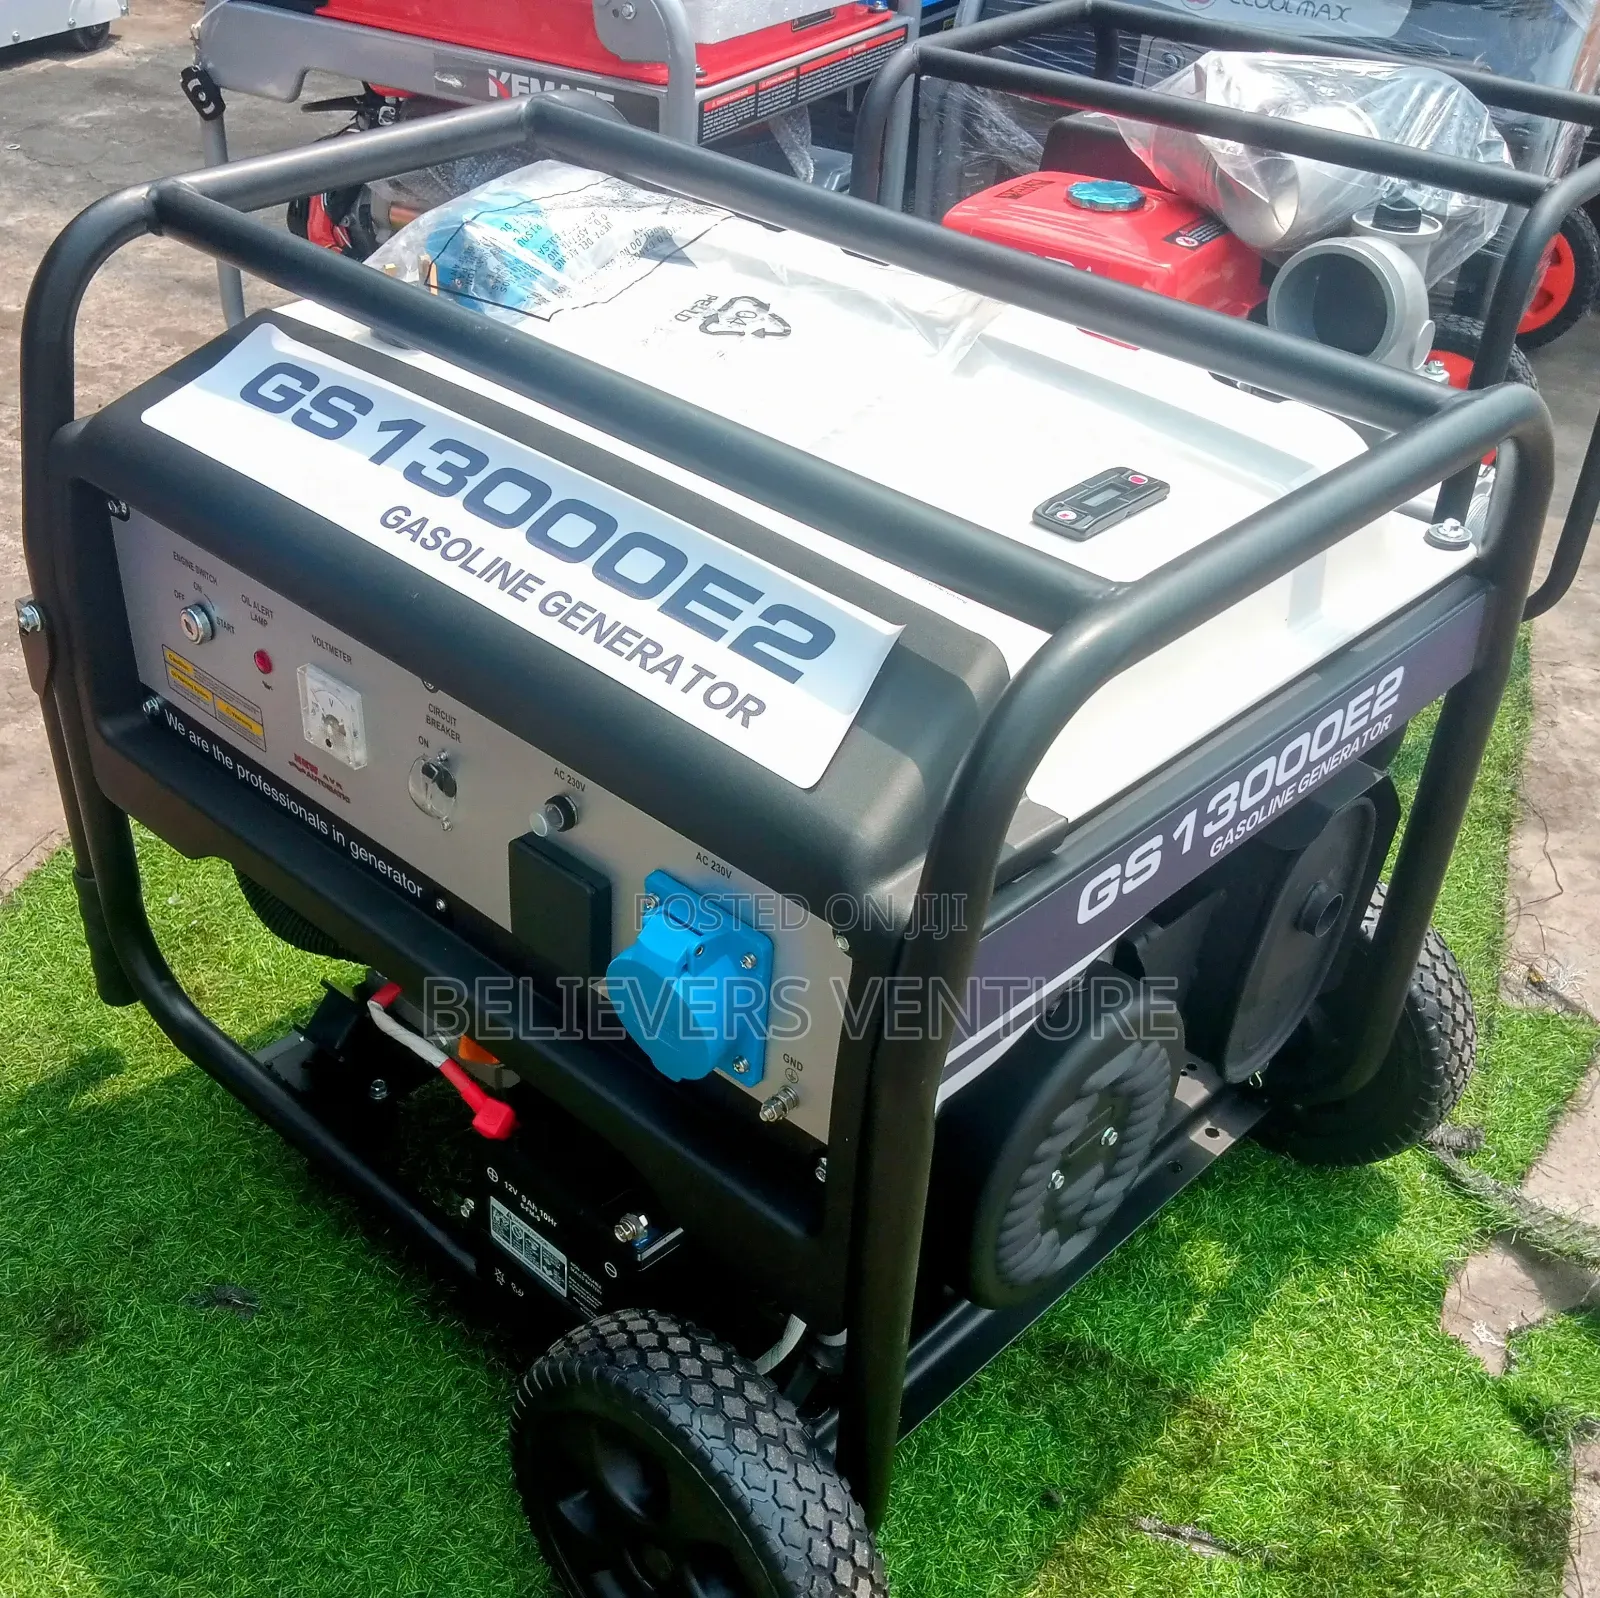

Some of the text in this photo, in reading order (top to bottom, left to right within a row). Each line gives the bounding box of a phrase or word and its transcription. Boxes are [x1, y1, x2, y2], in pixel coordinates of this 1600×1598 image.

[238, 361, 837, 685] GS13000E2
[173, 551, 218, 586] ENGINE SWITCH
[173, 589, 185, 601] OFF
[193, 581, 203, 594] ON
[241, 594, 274, 620] OIL ALERT
[379, 504, 766, 729] GASOLINE GENERATOR
[216, 616, 236, 635] START
[250, 613, 268, 628] LAMP
[311, 634, 353, 665] VOLTMETER
[428, 703, 457, 727] CIRCUIT
[418, 735, 429, 749] ON
[425, 715, 461, 743] BREAKER
[553, 766, 586, 792] AC 230V
[1209, 713, 1393, 859] GASOLINE GENERATOR
[165, 710, 186, 736] We
[189, 729, 210, 753] are
[212, 744, 233, 770] the
[237, 765, 328, 835] professionals
[332, 824, 346, 848] in
[350, 840, 424, 899] generator
[1077, 666, 1404, 924] GS13000E2
[695, 852, 733, 879] AC 230V
[782, 1053, 804, 1072] GND
[504, 1181, 518, 1196] 12V
